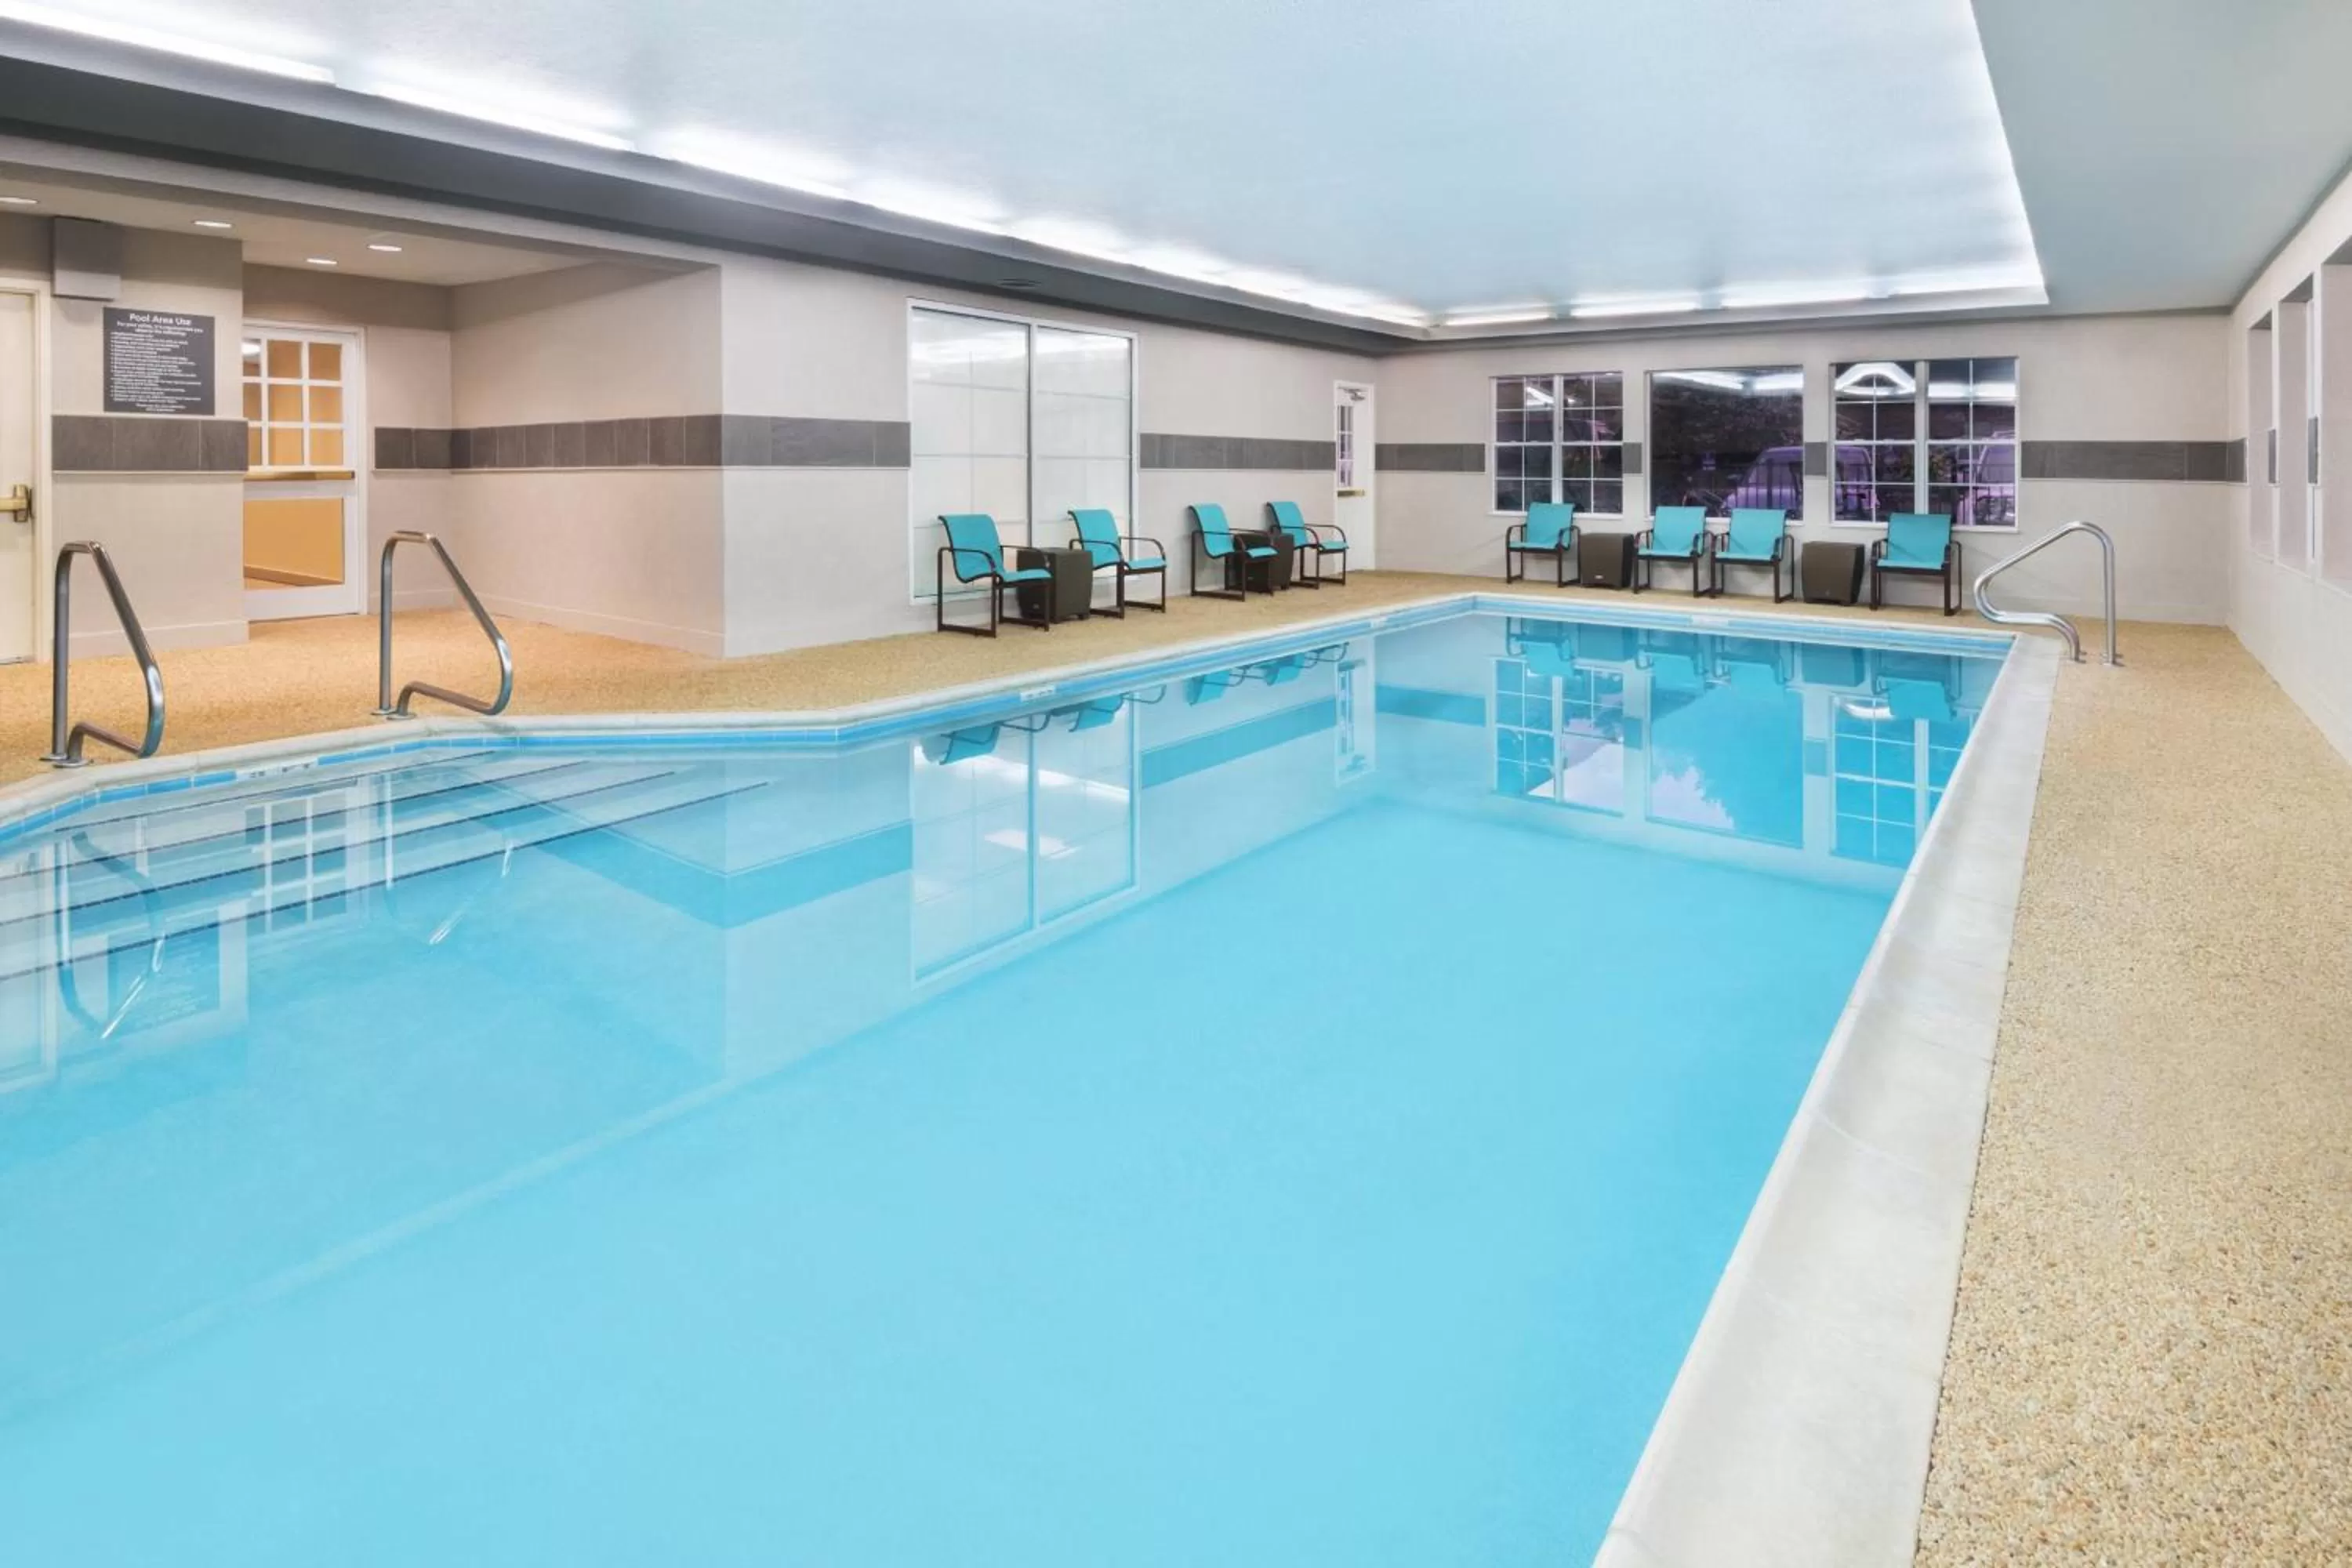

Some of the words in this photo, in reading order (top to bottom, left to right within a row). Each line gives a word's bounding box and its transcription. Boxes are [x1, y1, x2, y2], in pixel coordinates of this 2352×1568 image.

[129, 313, 151, 322] Pool
[152, 314, 174, 324] Area
[175, 317, 193, 326] Use
